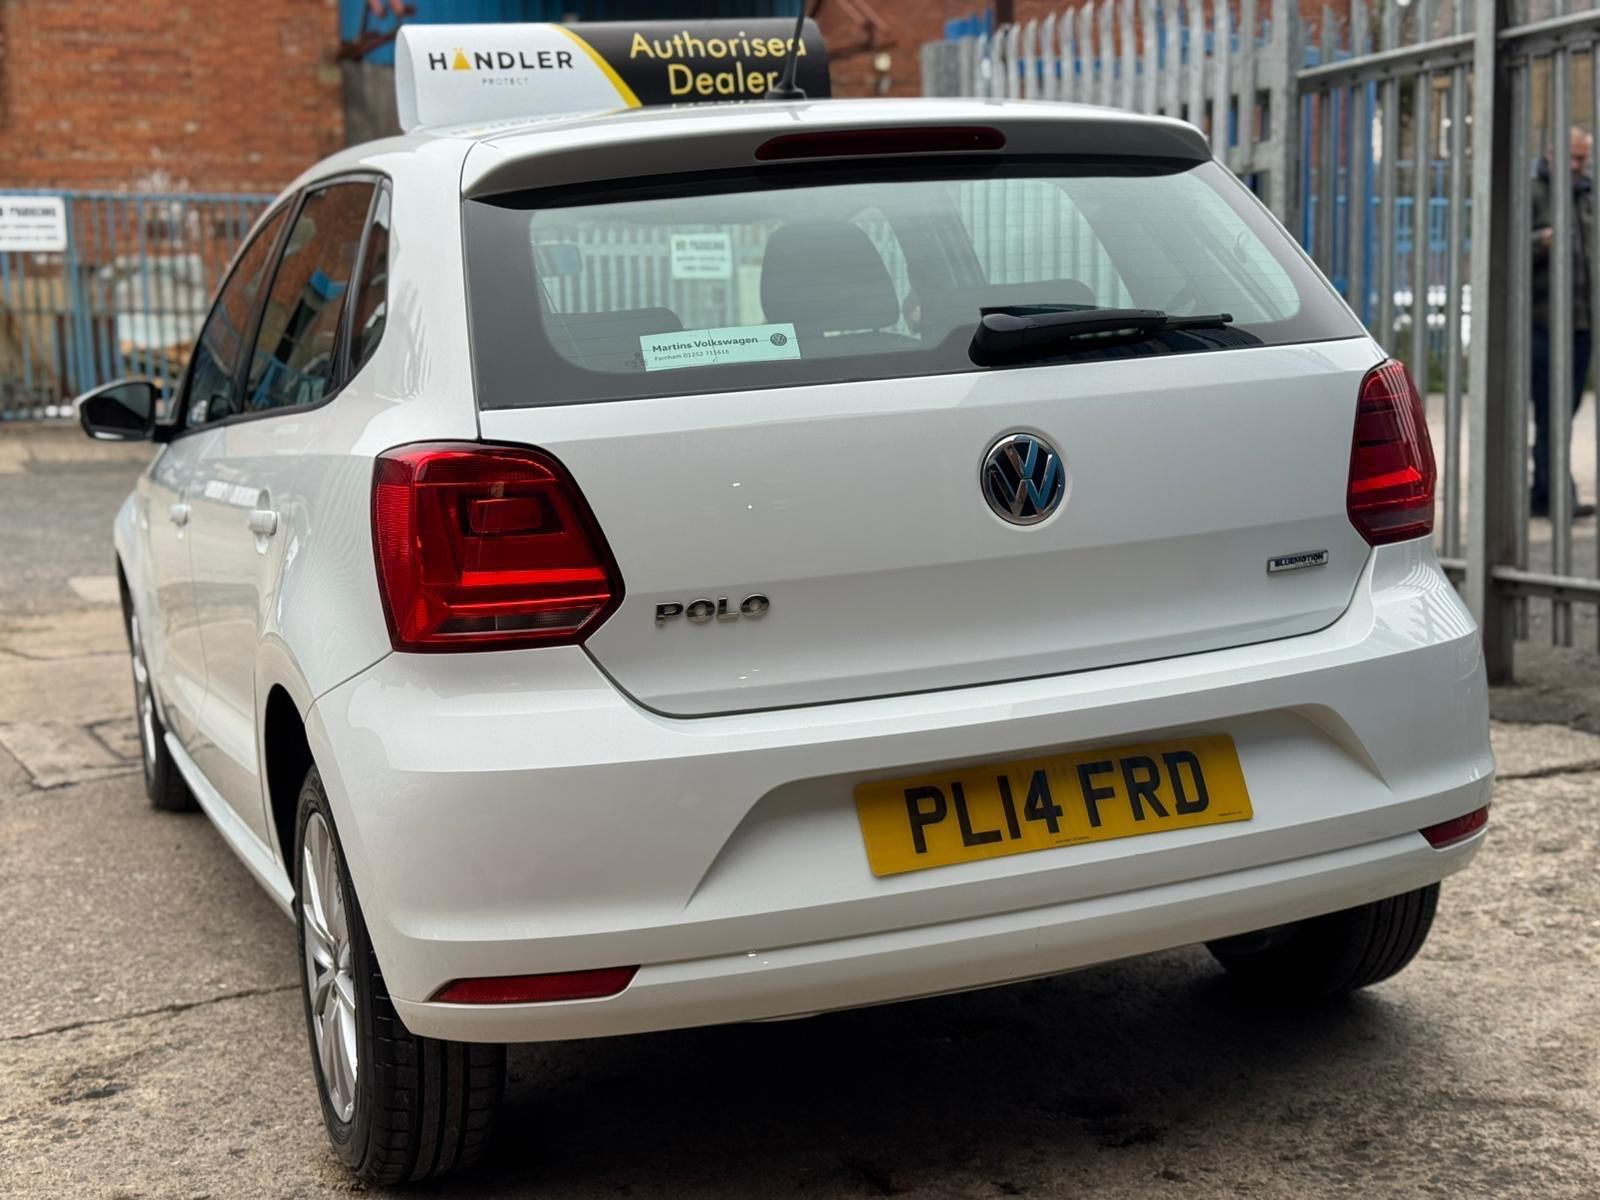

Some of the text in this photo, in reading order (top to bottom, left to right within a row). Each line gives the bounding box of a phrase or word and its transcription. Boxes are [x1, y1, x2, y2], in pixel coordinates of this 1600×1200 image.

[481, 77, 529, 86] PROTECT
[668, 62, 779, 96] Dealer
[652, 336, 759, 353] Martins Volkswagen
[683, 351, 704, 359] 01252
[655, 593, 770, 628] POLO
[903, 750, 1209, 854] PL14 FRD
